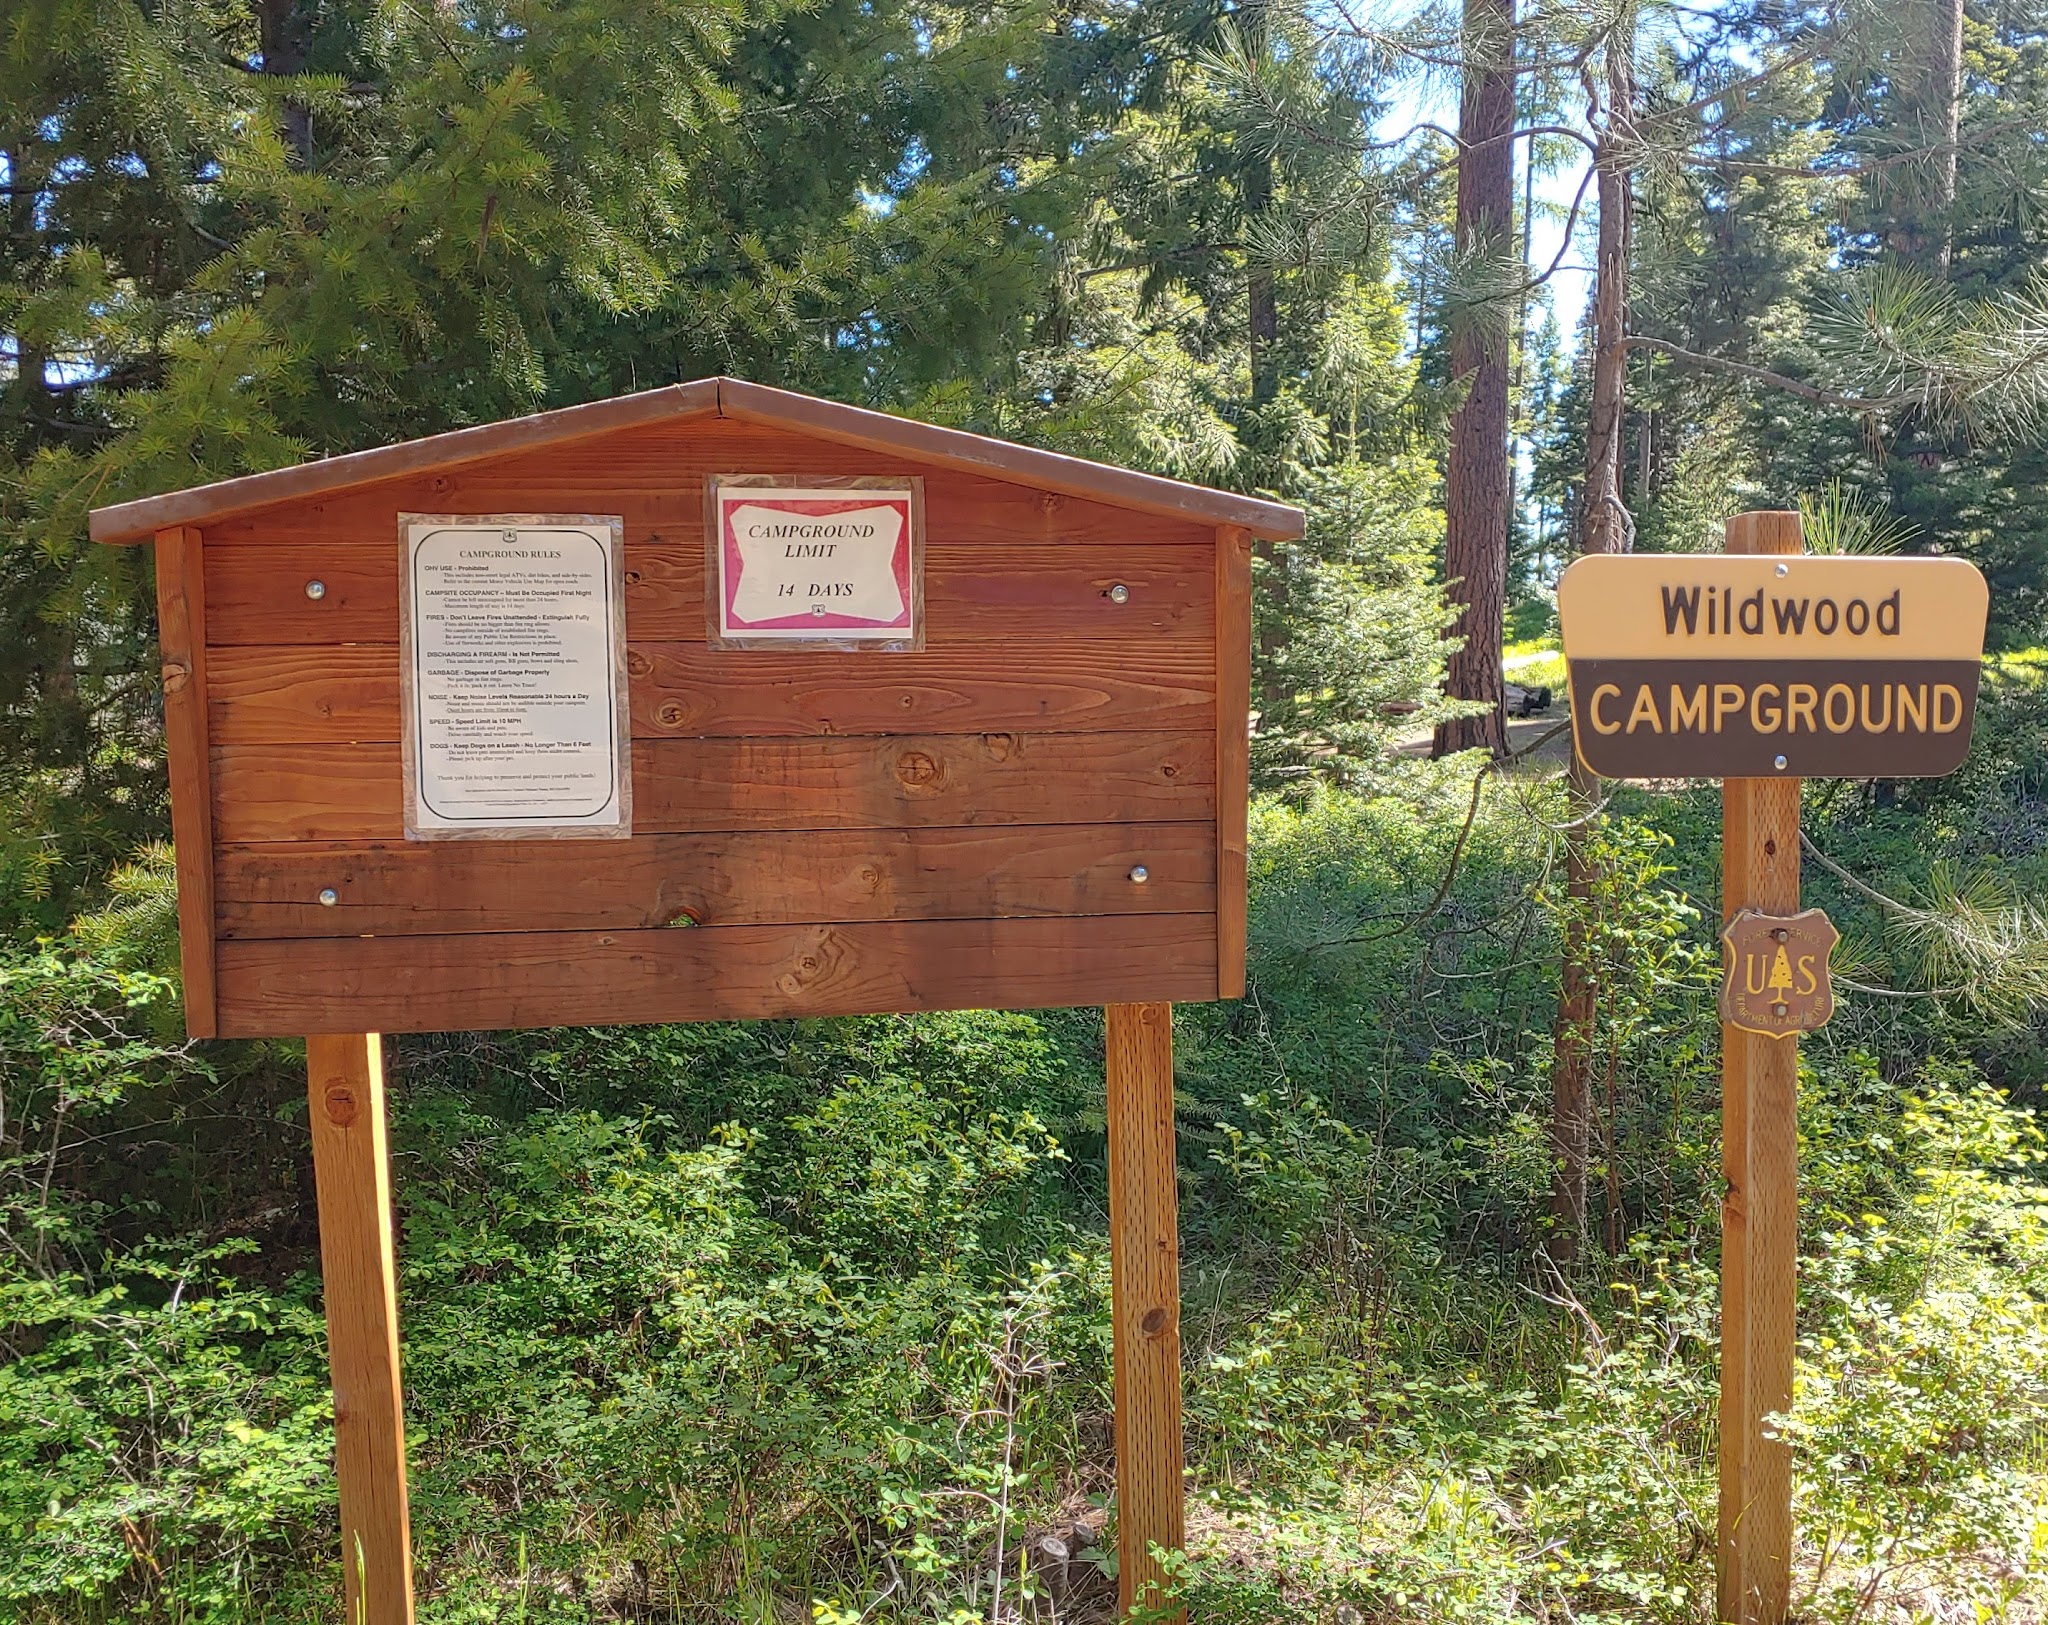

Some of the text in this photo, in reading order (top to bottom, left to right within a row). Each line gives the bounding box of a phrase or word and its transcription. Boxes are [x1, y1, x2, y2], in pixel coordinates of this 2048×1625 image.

[749, 525, 874, 538] CAMPGROUND
[785, 545, 836, 557] LIMIT
[778, 583, 853, 596] 14 DAYS
[1661, 586, 1901, 635] Wildwood
[1590, 683, 1962, 734] CAMPGROUND
[1746, 954, 1817, 995] U S
